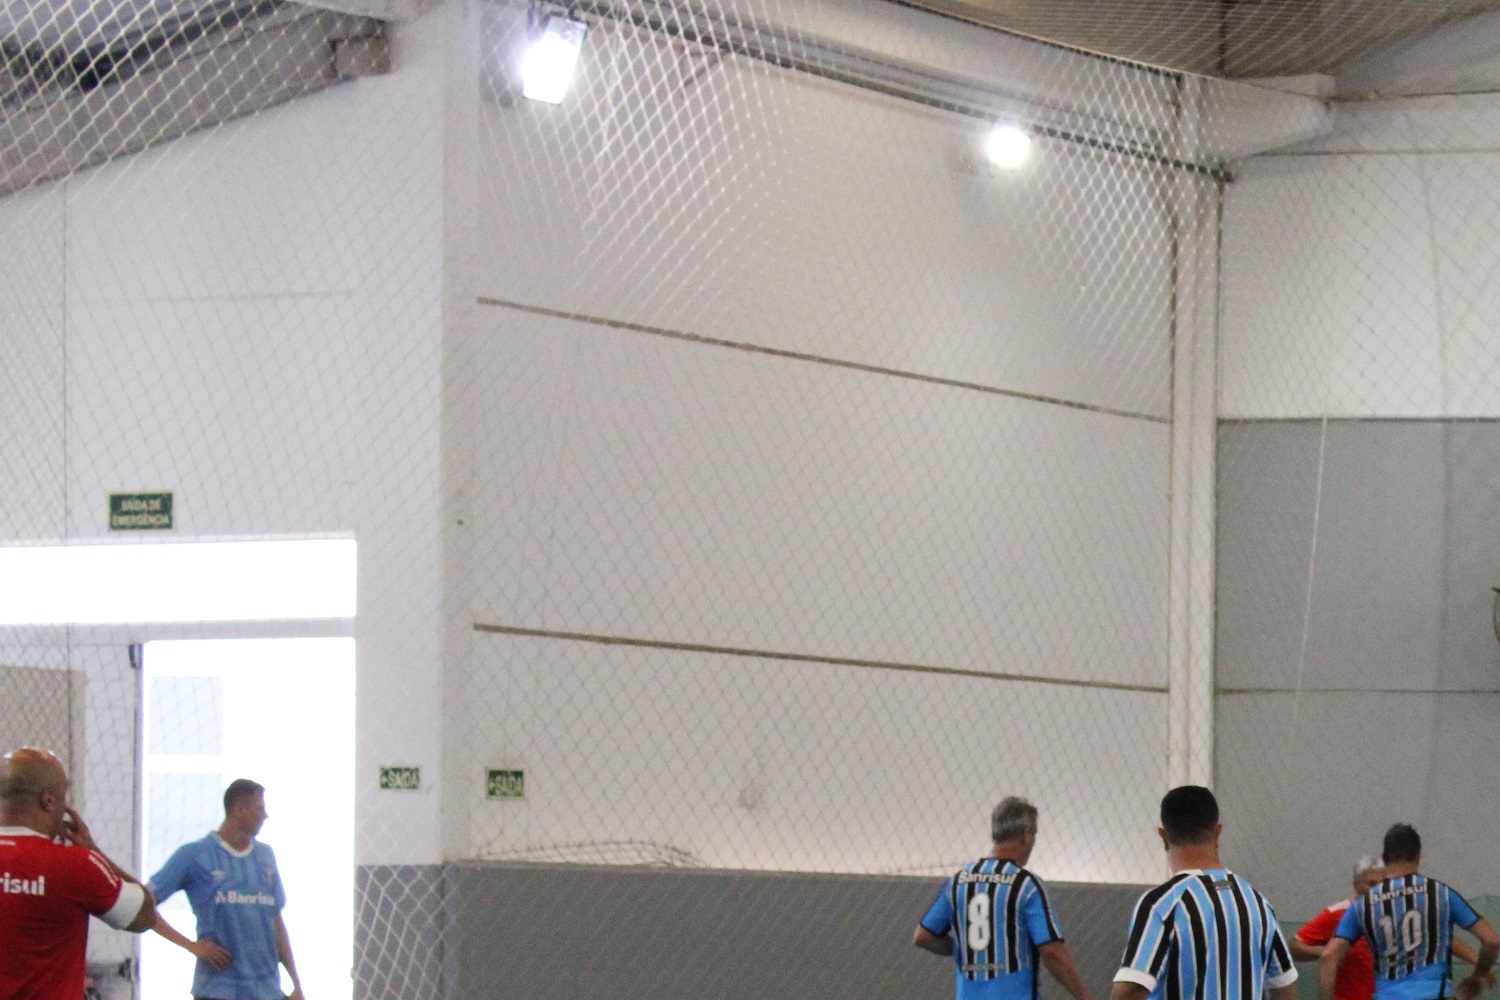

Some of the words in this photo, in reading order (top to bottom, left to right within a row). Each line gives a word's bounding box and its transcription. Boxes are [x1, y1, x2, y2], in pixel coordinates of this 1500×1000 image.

[958, 871, 1017, 885] Banrisul
[968, 892, 990, 950] 8
[1379, 910, 1423, 955] 10
